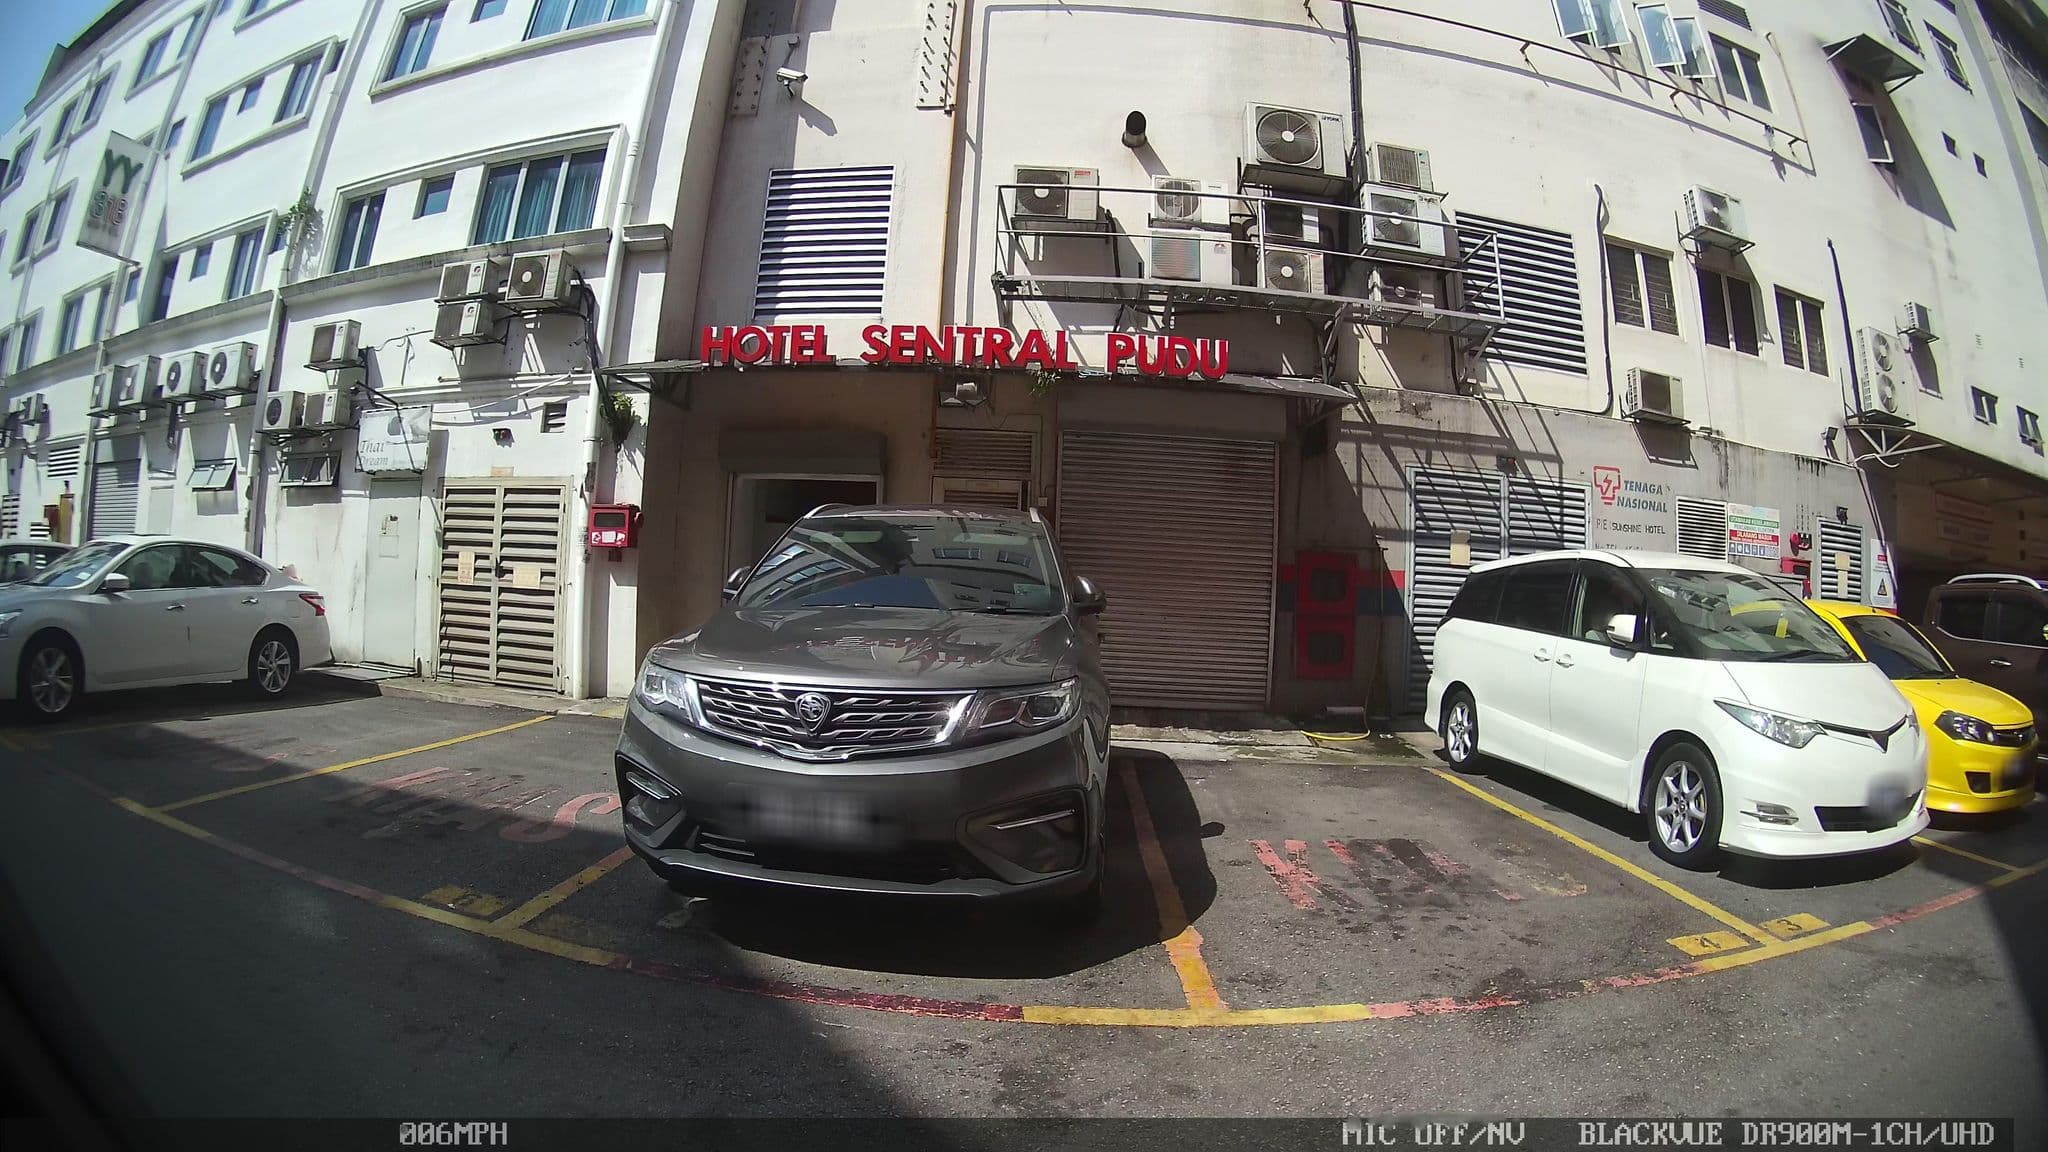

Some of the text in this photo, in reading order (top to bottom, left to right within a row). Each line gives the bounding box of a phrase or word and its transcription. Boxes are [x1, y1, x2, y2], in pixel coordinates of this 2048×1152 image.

[702, 325, 1229, 379] HOTEL SENTRAL PUDU
[1624, 480, 1663, 495] TENAGA
[1617, 496, 1667, 513] NASIONAL
[1612, 522, 1641, 533] SUNSHINE
[1645, 525, 1666, 535] HOTEL
